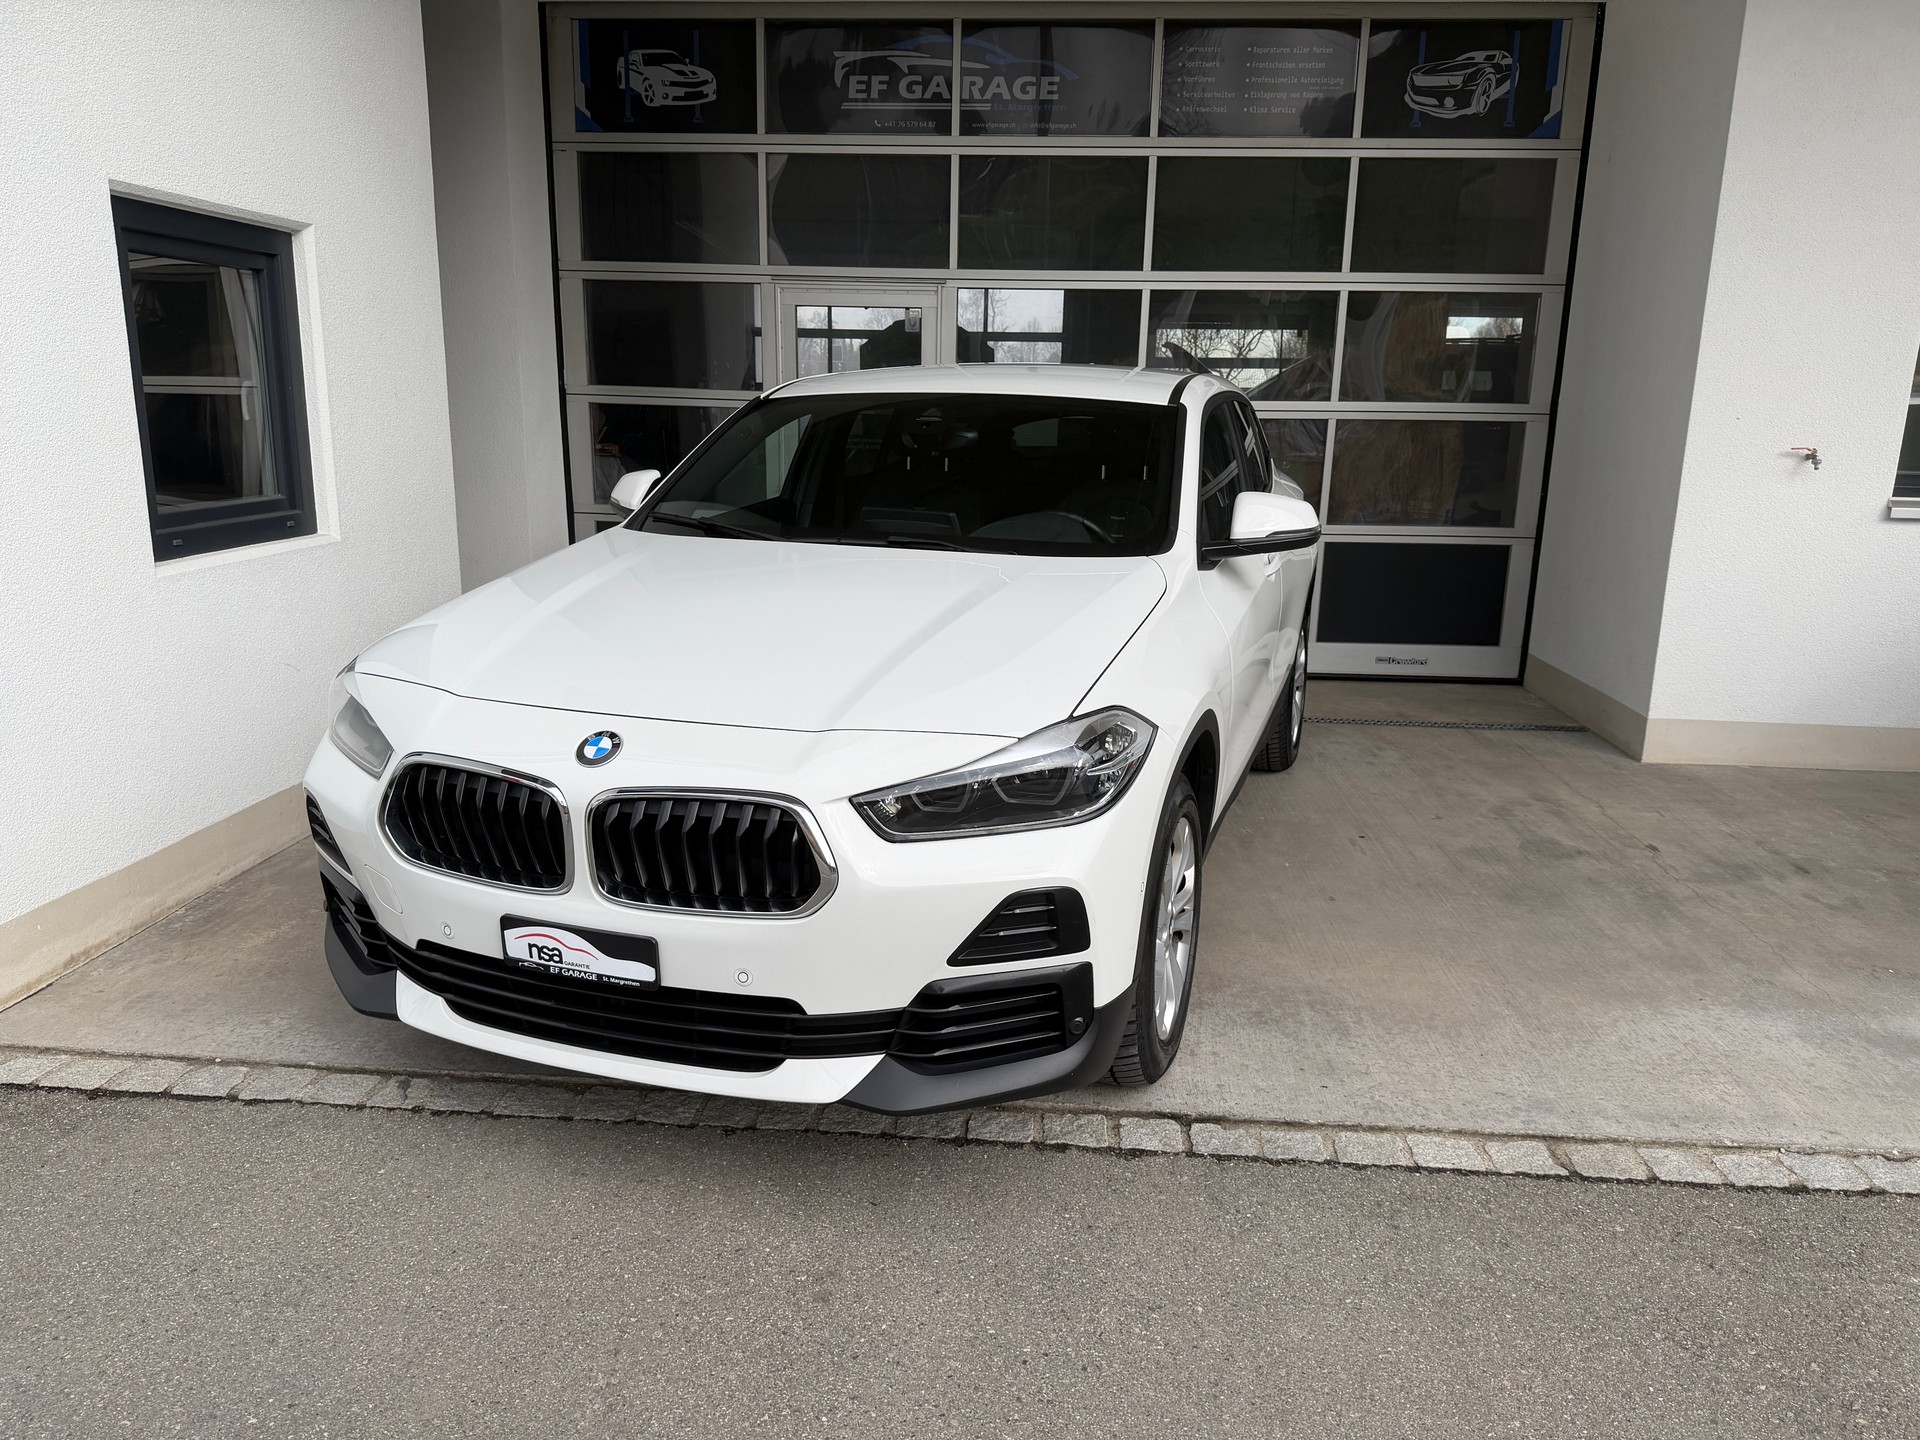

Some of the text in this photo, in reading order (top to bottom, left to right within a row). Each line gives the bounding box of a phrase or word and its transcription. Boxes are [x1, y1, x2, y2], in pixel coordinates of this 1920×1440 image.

[848, 75, 1061, 100] EF GARAGE
[897, 120, 906, 128] 76
[906, 120, 918, 128] 579
[919, 120, 927, 128] 64
[928, 120, 936, 128] 82
[527, 942, 564, 965] nsa
[563, 960, 591, 970] GARANTIE
[550, 966, 560, 974] EF
[561, 968, 598, 981] GARAGE
[610, 977, 640, 987] Margrethen
